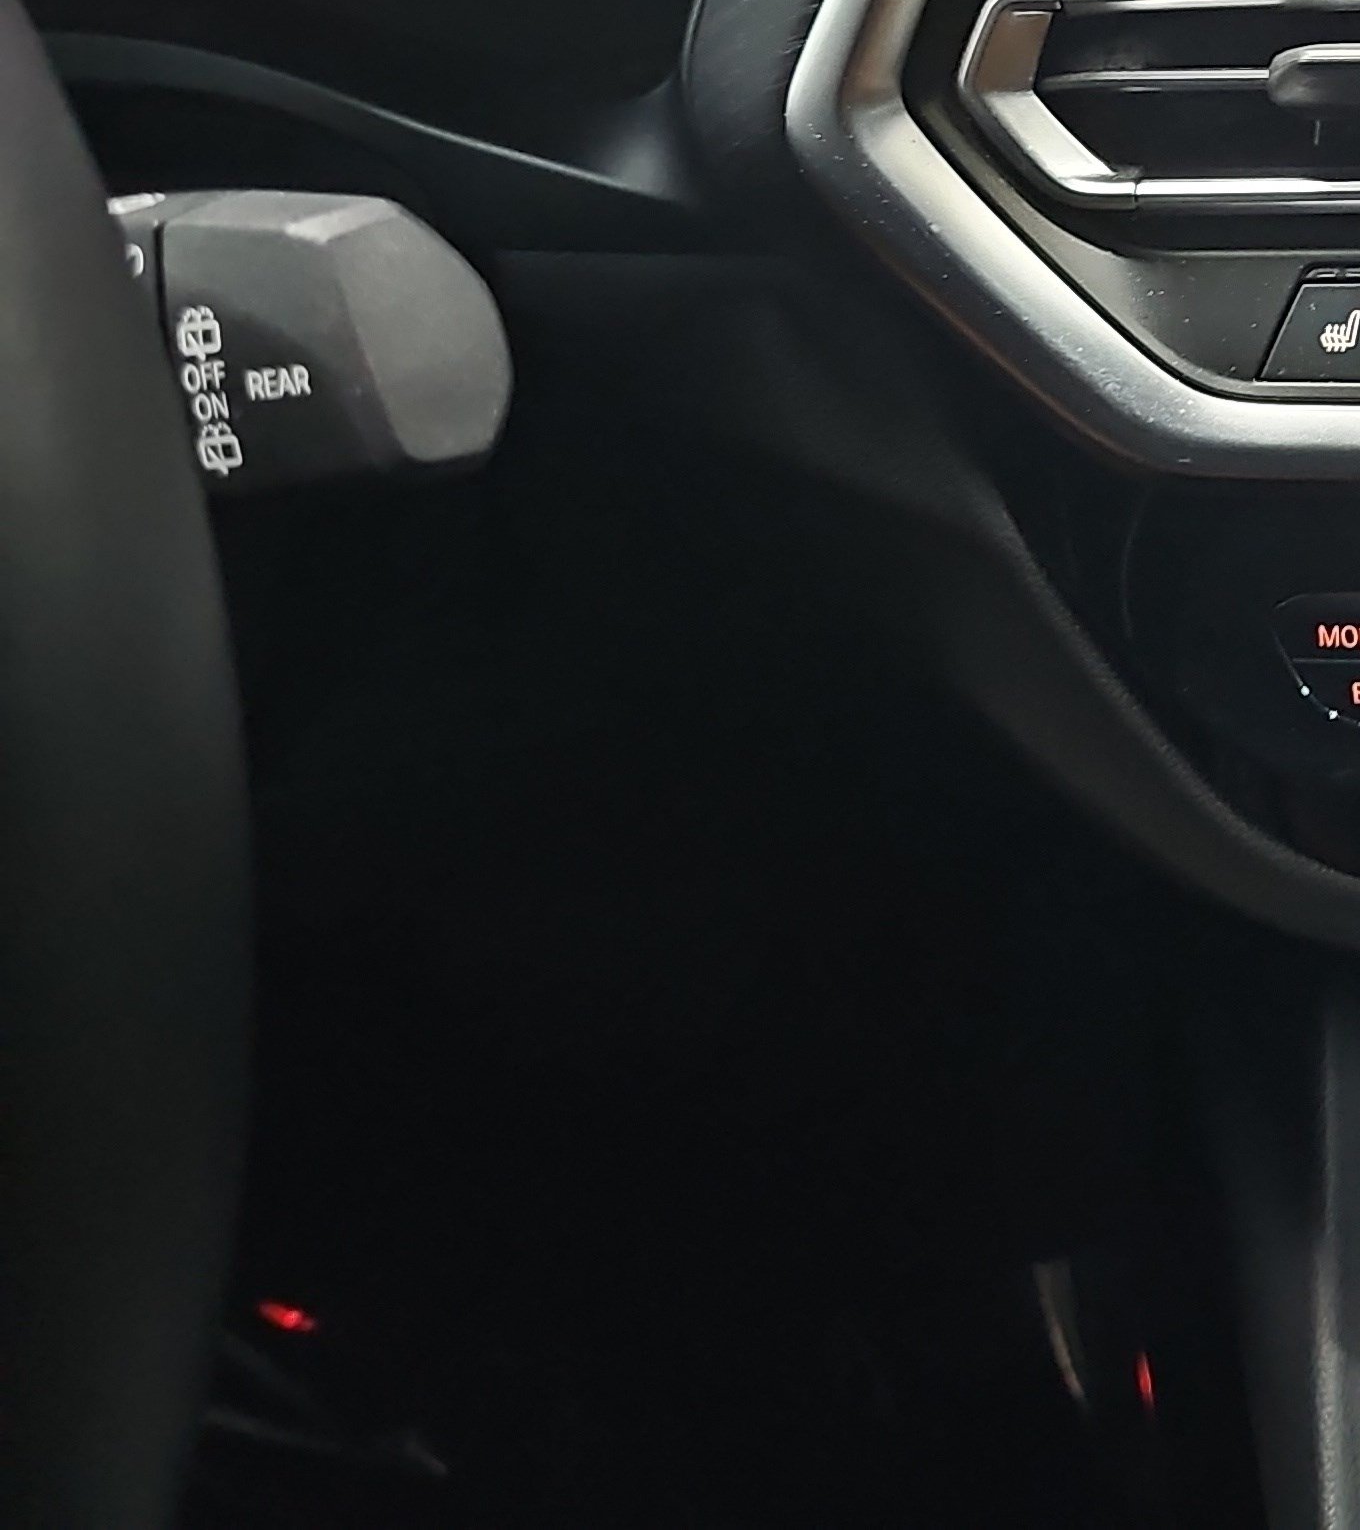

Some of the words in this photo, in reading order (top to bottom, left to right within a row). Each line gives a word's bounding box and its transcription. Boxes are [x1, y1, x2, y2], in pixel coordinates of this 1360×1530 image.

[181, 360, 226, 394] OFF
[245, 363, 312, 401] REAR
[192, 392, 230, 422] ON
